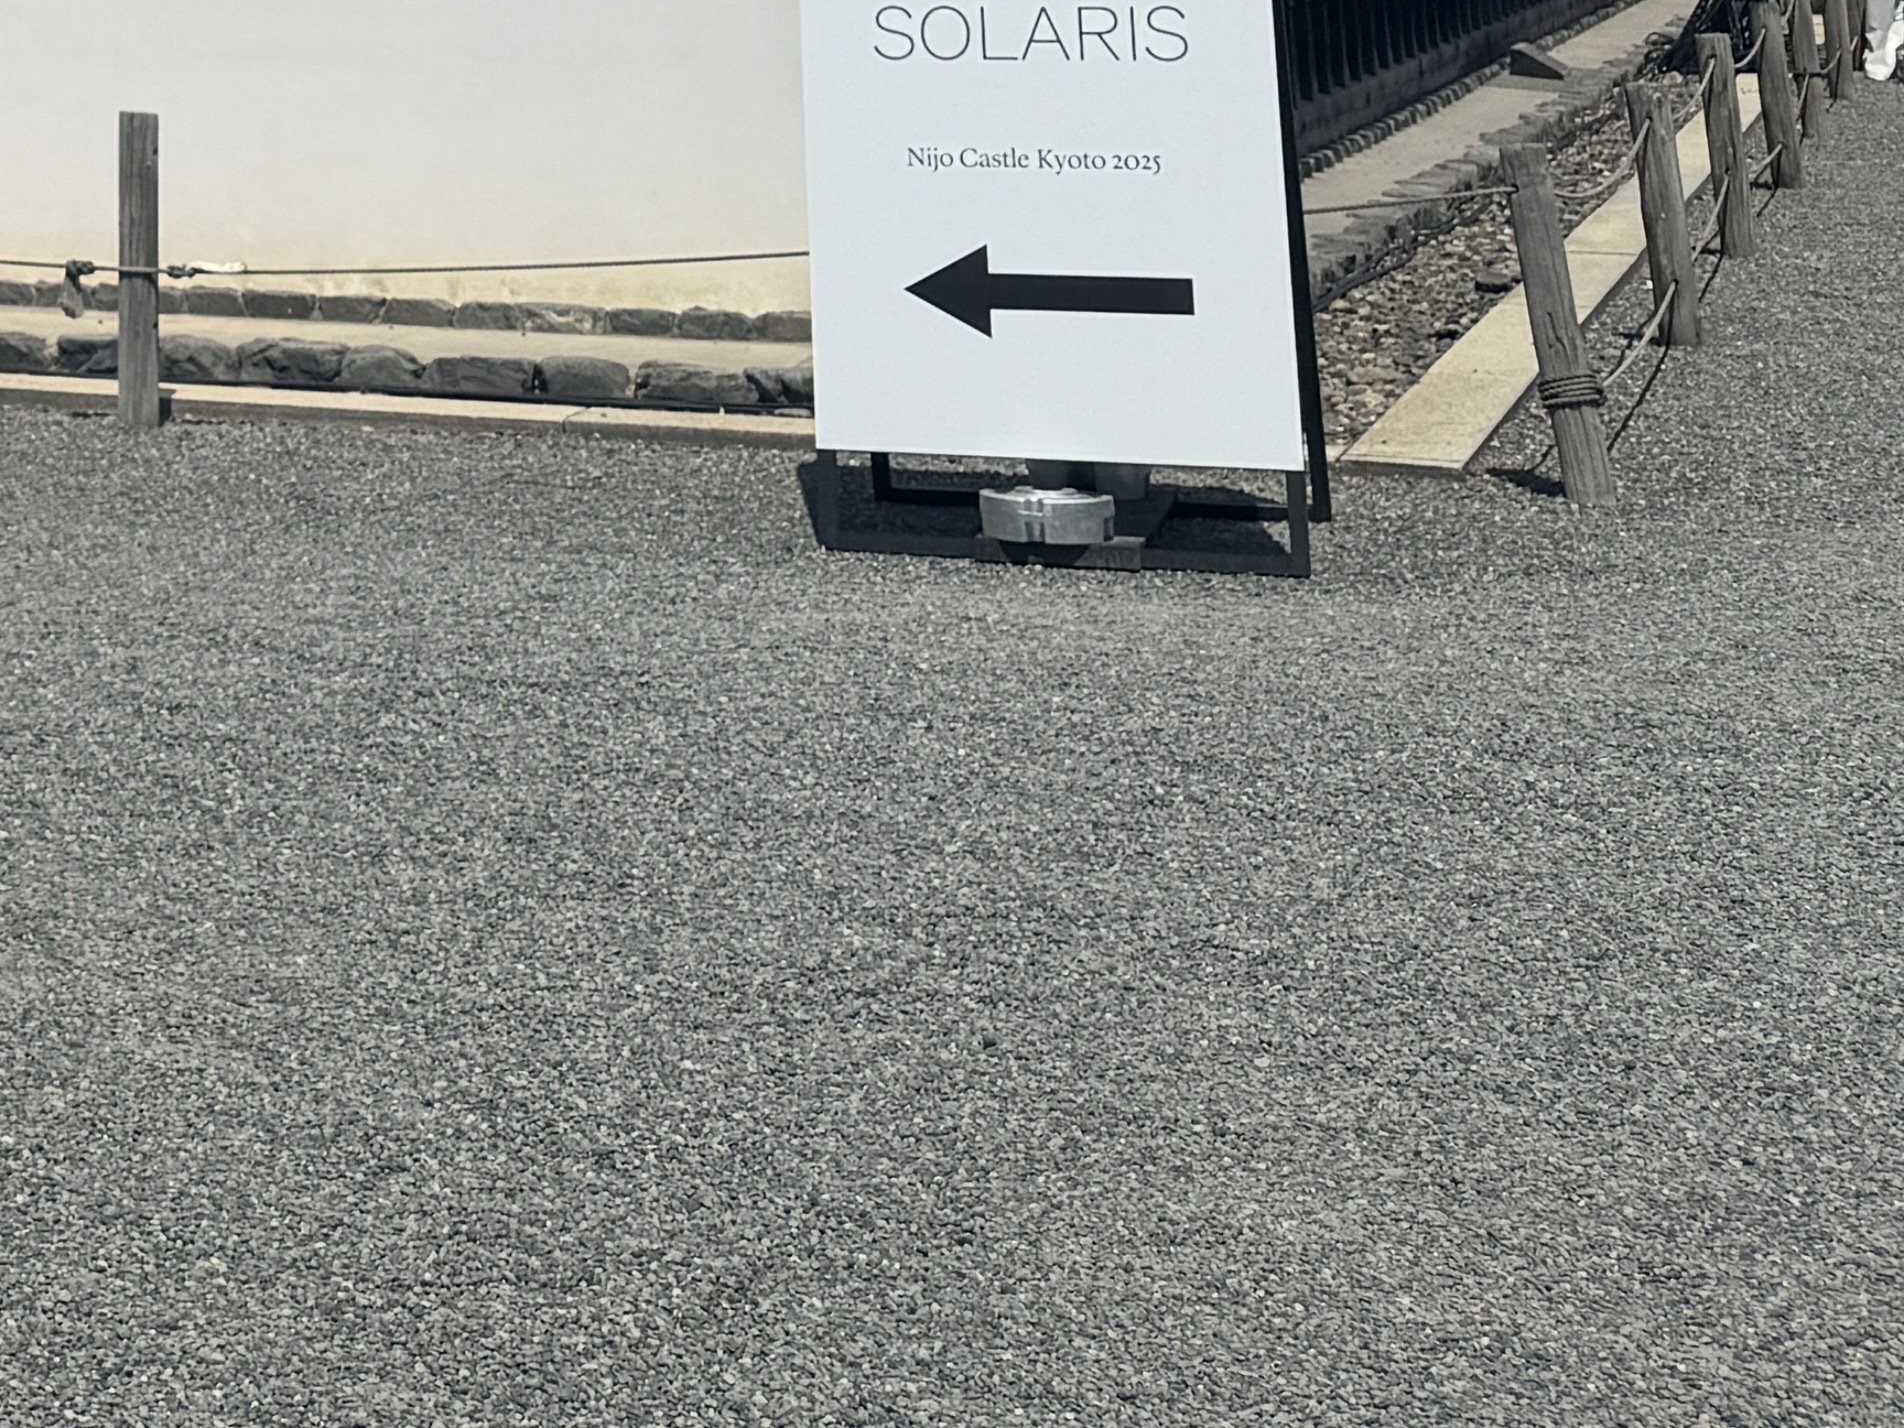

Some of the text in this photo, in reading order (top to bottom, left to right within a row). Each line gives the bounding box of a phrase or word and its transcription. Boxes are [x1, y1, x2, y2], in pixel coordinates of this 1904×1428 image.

[872, 4, 1190, 63] SOLARIS
[906, 146, 1163, 177] Nijo Castle Kyoto 2025
